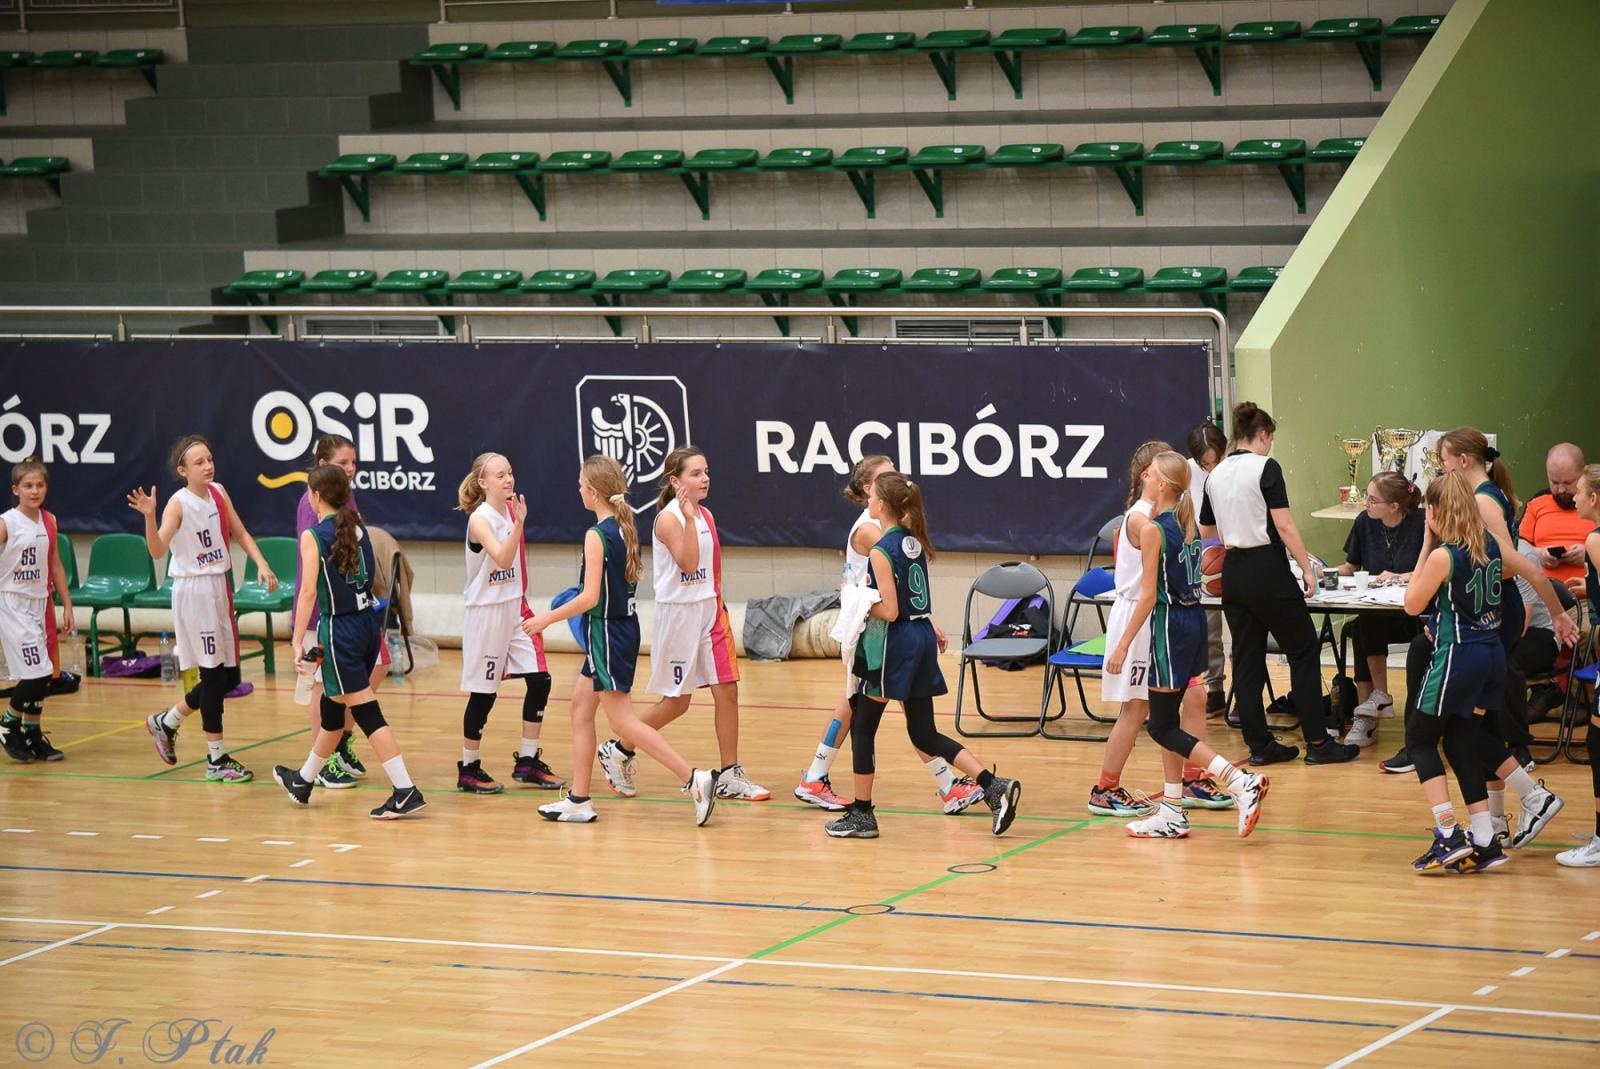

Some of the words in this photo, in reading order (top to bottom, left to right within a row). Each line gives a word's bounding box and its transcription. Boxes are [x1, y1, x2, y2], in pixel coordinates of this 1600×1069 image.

[0, 394, 115, 464] ÓRZ
[755, 402, 1109, 479] RACIBÓRZ
[350, 465, 436, 491] CIBÓRZ
[196, 528, 212, 549] 16
[196, 548, 224, 567] MINI
[1178, 539, 1203, 585] 12
[13, 568, 41, 581] MINI
[488, 567, 516, 582] MINI
[1465, 557, 1502, 614] 16
[907, 562, 928, 610] 9
[21, 645, 41, 667] 55
[201, 635, 216, 656] 16
[485, 660, 496, 681] 2
[673, 665, 683, 686] 9
[1130, 665, 1147, 687] 27
